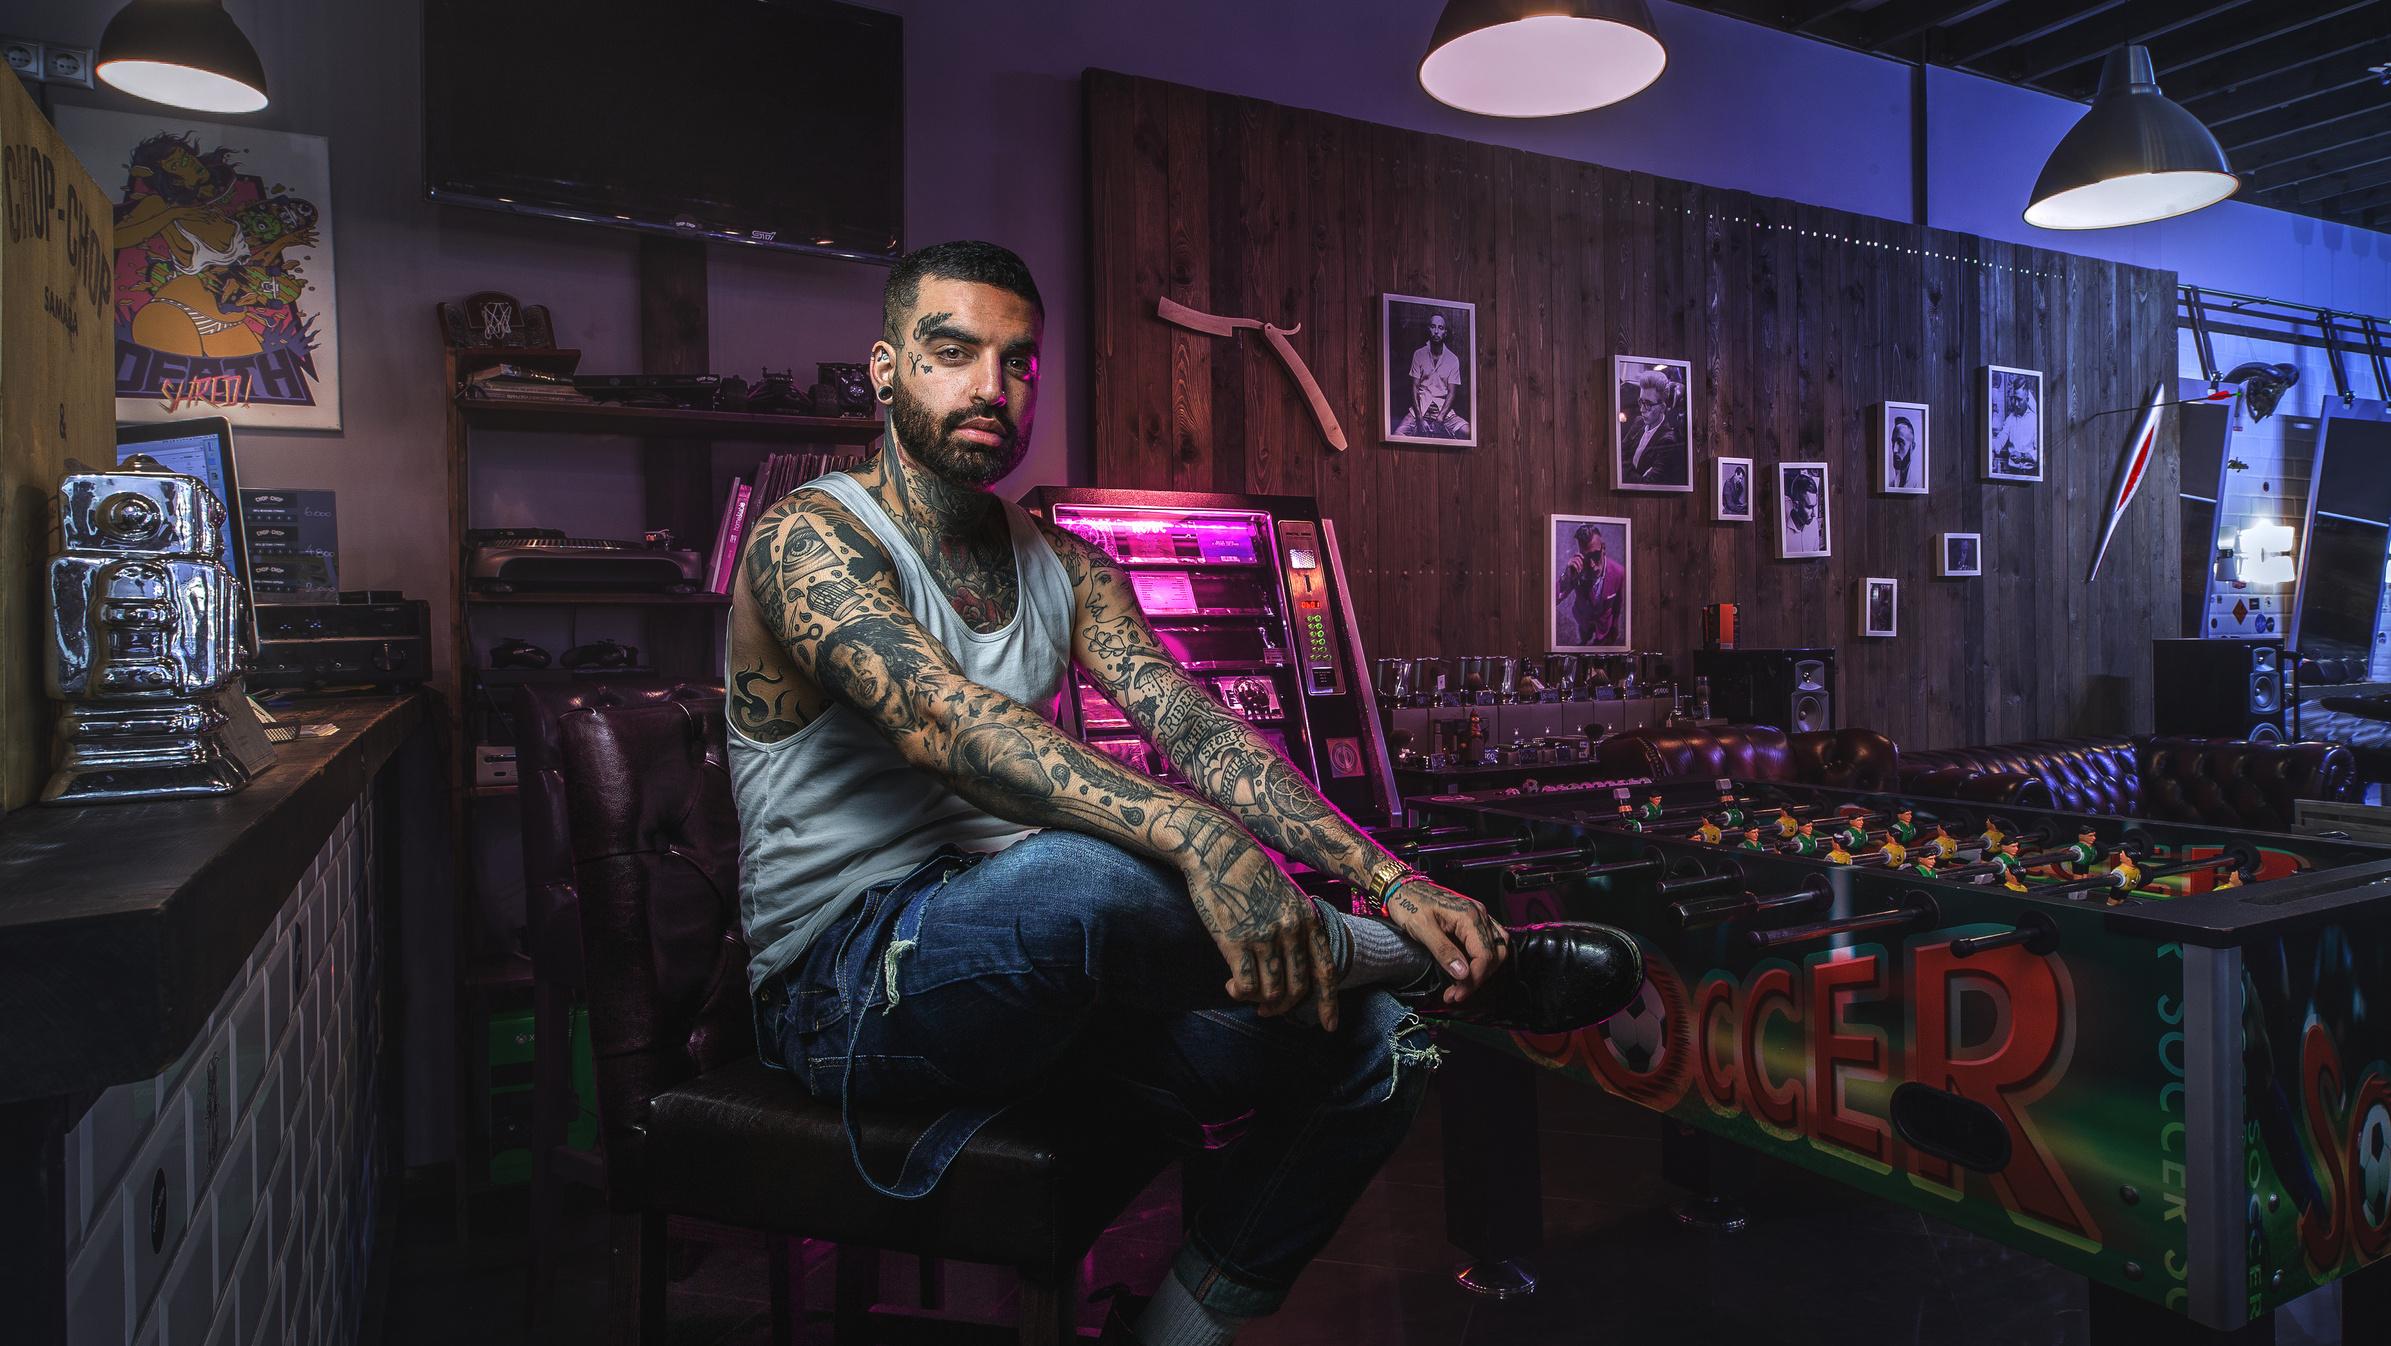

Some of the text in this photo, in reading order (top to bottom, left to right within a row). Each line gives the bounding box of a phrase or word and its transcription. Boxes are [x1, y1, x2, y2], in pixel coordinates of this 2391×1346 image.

[1163, 686, 1202, 733] RIDERS
[1172, 723, 1208, 765] ON THE
[1201, 725, 1245, 759] STORM
[1516, 937, 2094, 1240] OCCER
[2247, 1119, 2262, 1320] SOCCER
